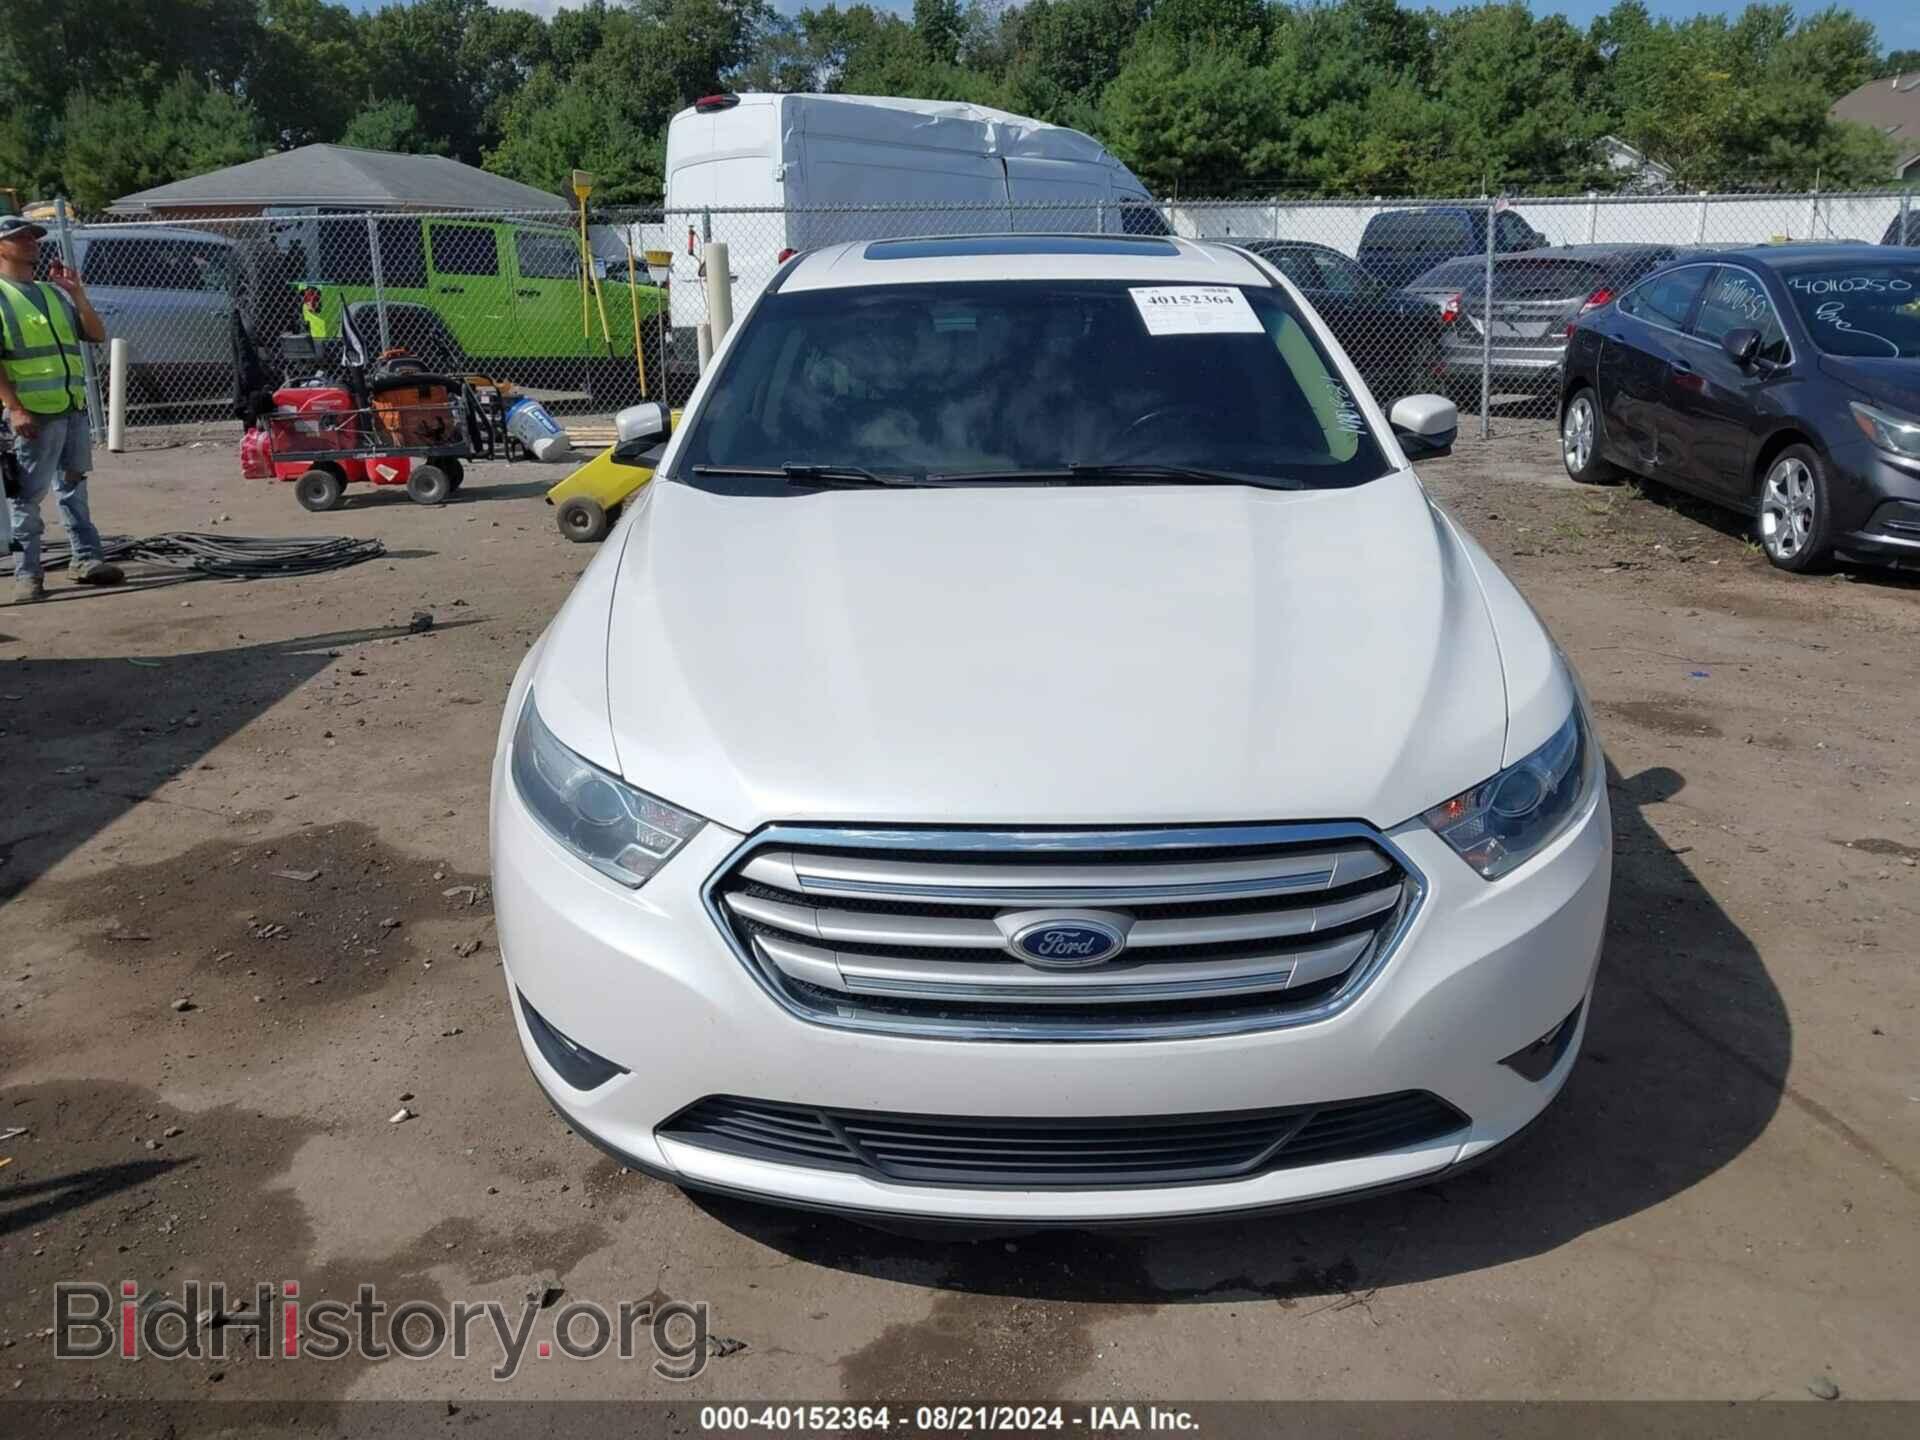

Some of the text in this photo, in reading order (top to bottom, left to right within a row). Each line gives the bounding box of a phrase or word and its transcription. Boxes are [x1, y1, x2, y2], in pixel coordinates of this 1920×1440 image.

[1788, 277, 1913, 294] 40110250
[1147, 295, 1235, 305] 40152364
[1038, 931, 1095, 954] Ford
